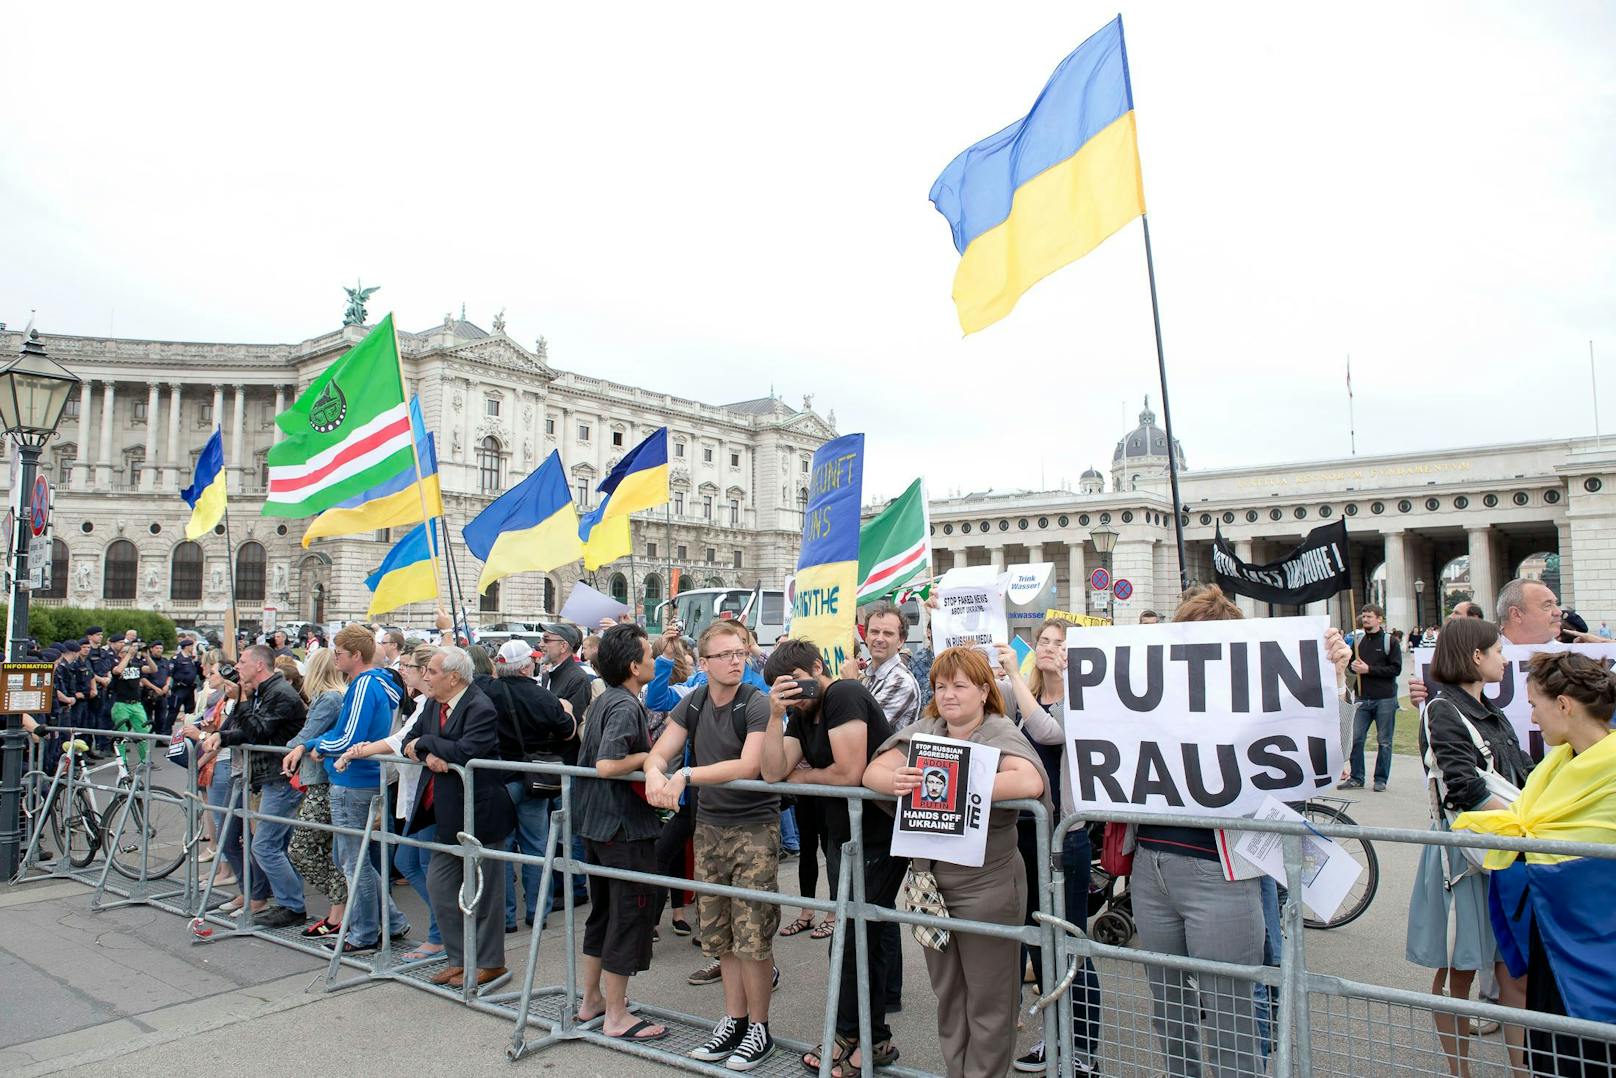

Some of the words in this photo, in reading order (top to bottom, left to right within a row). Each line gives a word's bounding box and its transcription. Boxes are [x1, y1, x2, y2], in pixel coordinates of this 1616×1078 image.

[1018, 575, 1036, 583] Trink
[1011, 582, 1041, 590] Wasser!
[944, 596, 958, 607] STOP
[958, 595, 974, 605] FAKED
[973, 593, 988, 604] NEWS
[951, 606, 965, 615] ABOUT
[966, 605, 985, 613] UKRAINE
[945, 637, 952, 648] IN
[952, 634, 975, 647] RUSSIAN
[975, 633, 993, 645] MEDIA
[1067, 639, 1324, 713] PUTIN
[915, 743, 932, 751] STOP
[932, 744, 963, 755] RUSSIAN
[918, 750, 960, 760] AGGRESSOR
[923, 759, 954, 769] ADOLF
[1075, 735, 1332, 808] RAUS!
[920, 801, 949, 810] PUTIN
[903, 810, 939, 820] HANDS
[941, 812, 962, 822] OFF
[908, 819, 956, 831] UKRAINE
